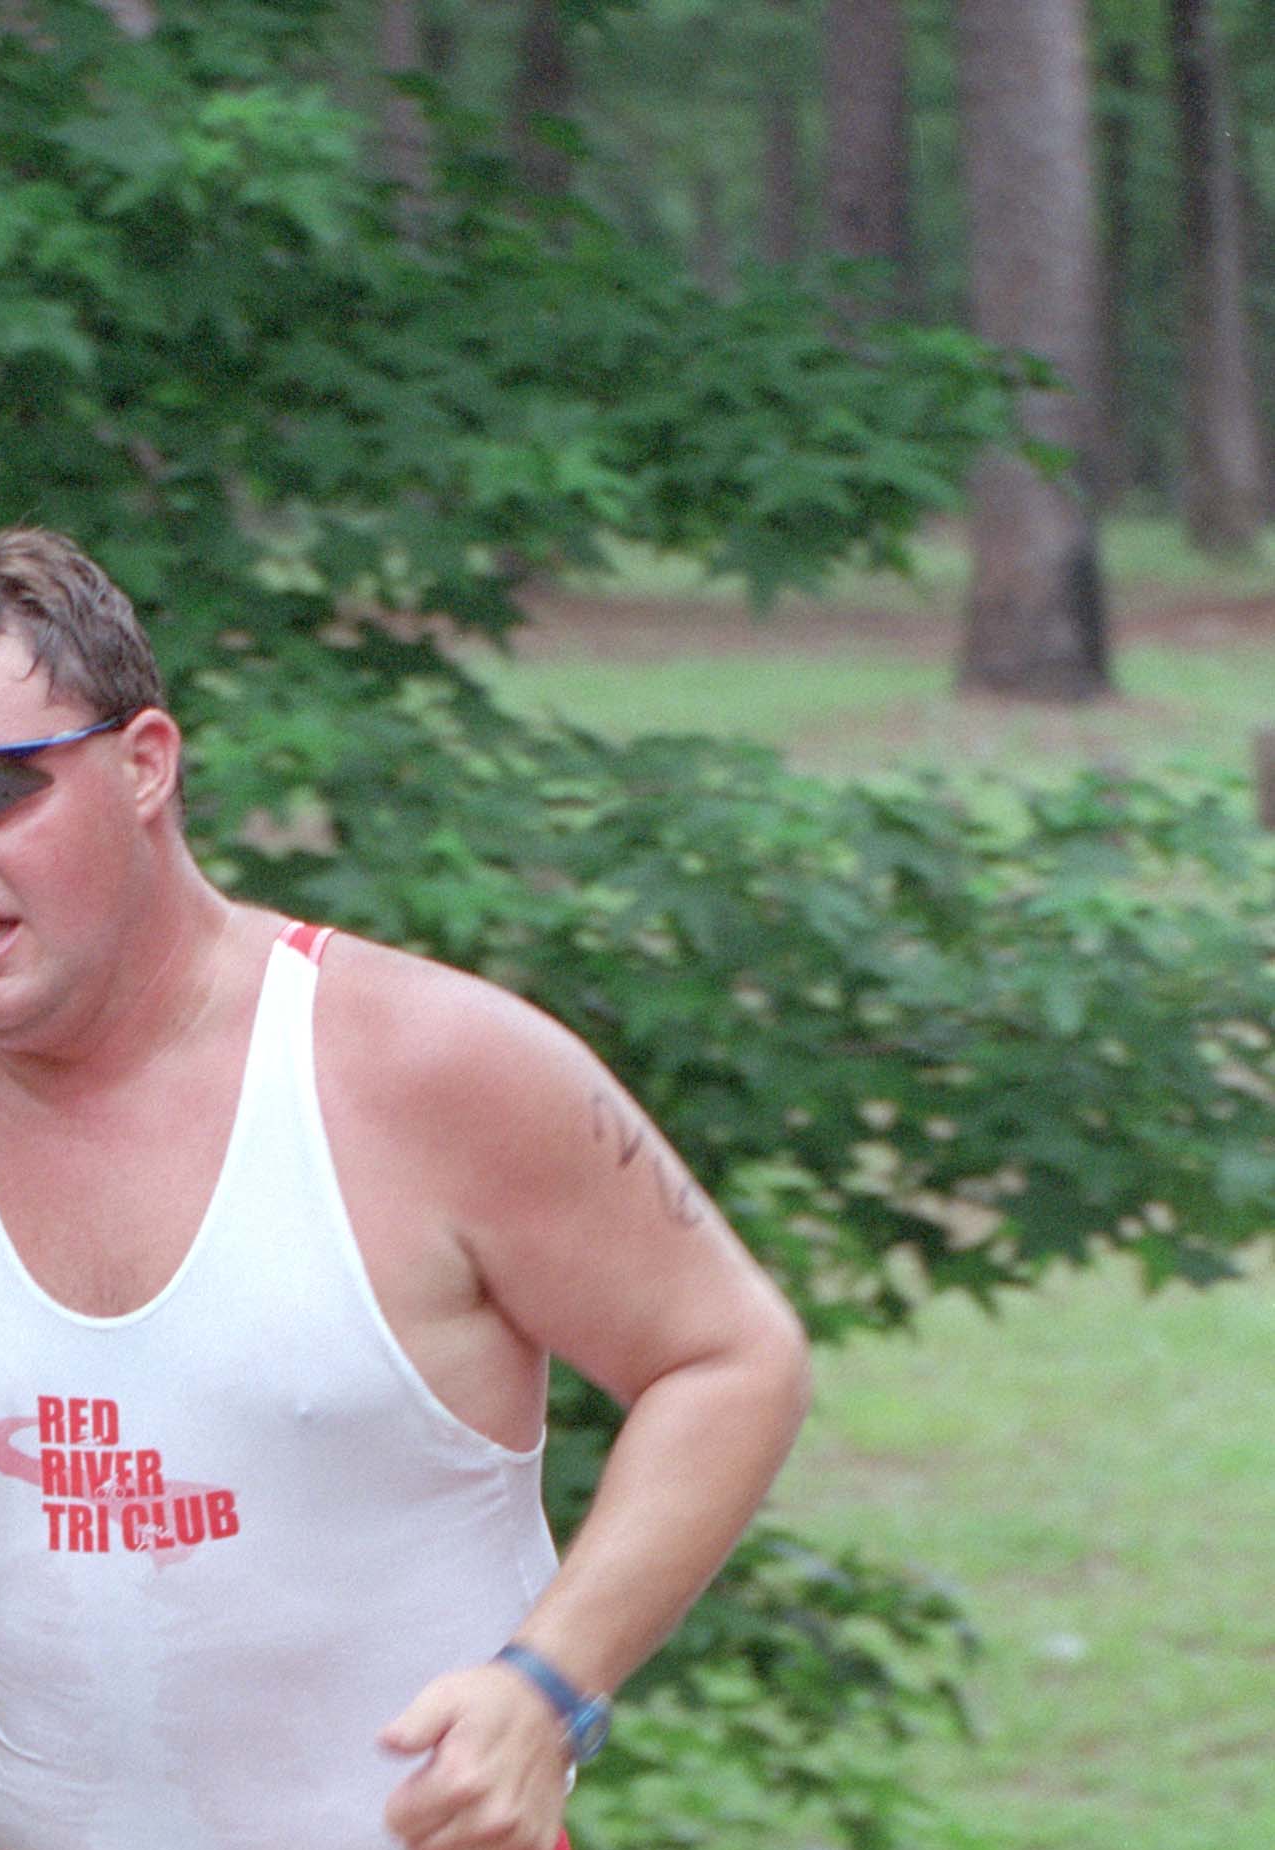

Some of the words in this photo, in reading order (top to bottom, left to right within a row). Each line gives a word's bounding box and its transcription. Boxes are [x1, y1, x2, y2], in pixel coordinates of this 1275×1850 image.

[37, 1395, 119, 1446] RED
[41, 1448, 164, 1499] RIVER
[42, 1502, 110, 1553] TRI
[120, 1489, 240, 1553] CLUB
